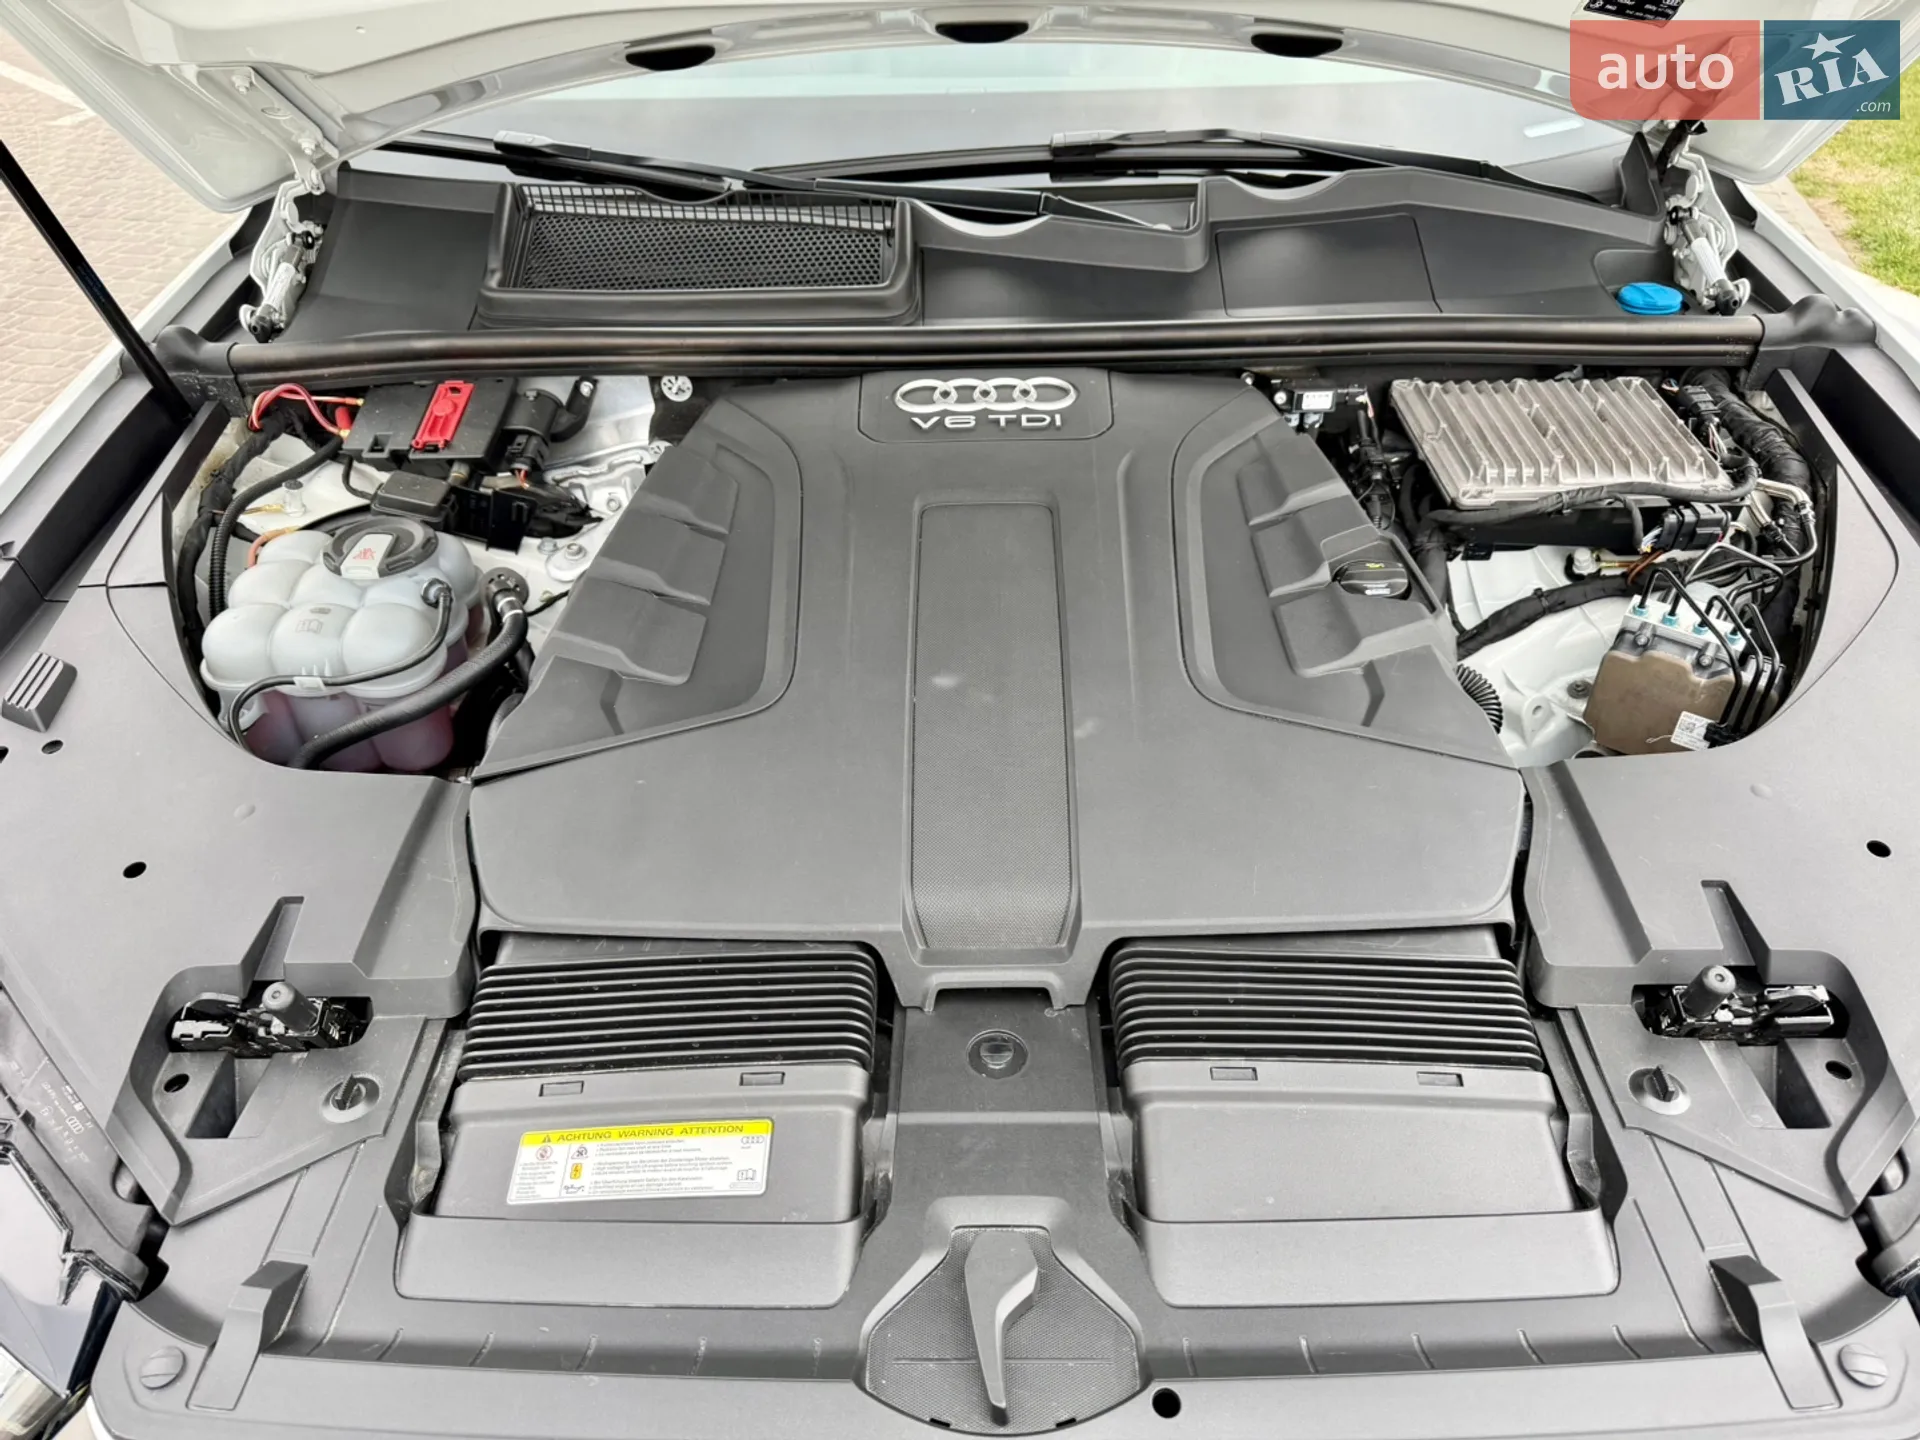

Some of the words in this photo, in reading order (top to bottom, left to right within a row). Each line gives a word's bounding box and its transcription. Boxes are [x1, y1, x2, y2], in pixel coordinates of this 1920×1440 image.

[911, 415, 976, 430] V6
[988, 413, 1062, 430] TDI
[556, 1132, 612, 1143] ACHTUNG
[617, 1128, 674, 1138] WARNING
[679, 1124, 744, 1135] ATTENTION
